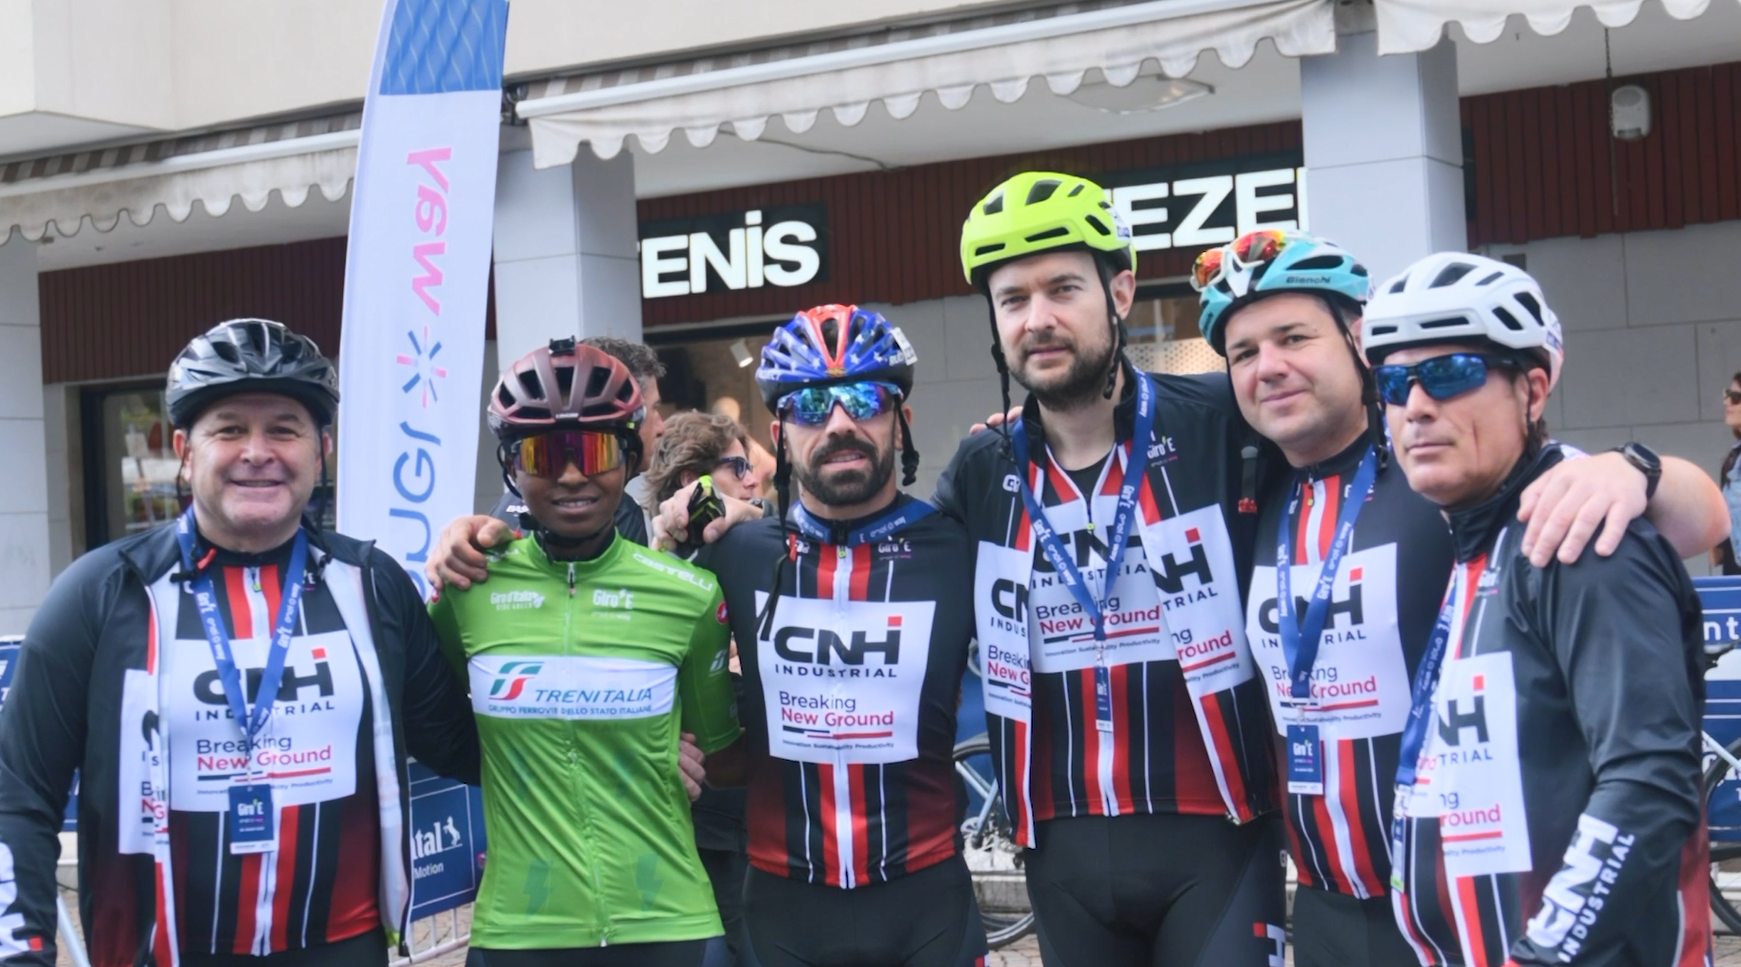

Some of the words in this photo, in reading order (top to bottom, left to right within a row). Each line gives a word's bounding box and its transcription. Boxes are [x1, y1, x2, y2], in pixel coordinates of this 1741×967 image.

[638, 210, 821, 299] ENiS
[1286, 276, 1331, 284] Bianchi
[1039, 617, 1083, 635] New
[773, 616, 902, 666] CNH
[775, 664, 897, 678] INDUSTRIAL
[987, 661, 1017, 681] New
[535, 688, 653, 703] TRENITALIA
[779, 691, 856, 713] Breaking
[488, 705, 516, 714] GRUPPO
[590, 706, 618, 715] STATO
[781, 707, 818, 726] New
[825, 710, 894, 727] Ground
[198, 755, 249, 772] New
[257, 745, 332, 766] Ground
[1526, 812, 1620, 948] CNH
[1557, 832, 1636, 963] INDUSTRIAL
